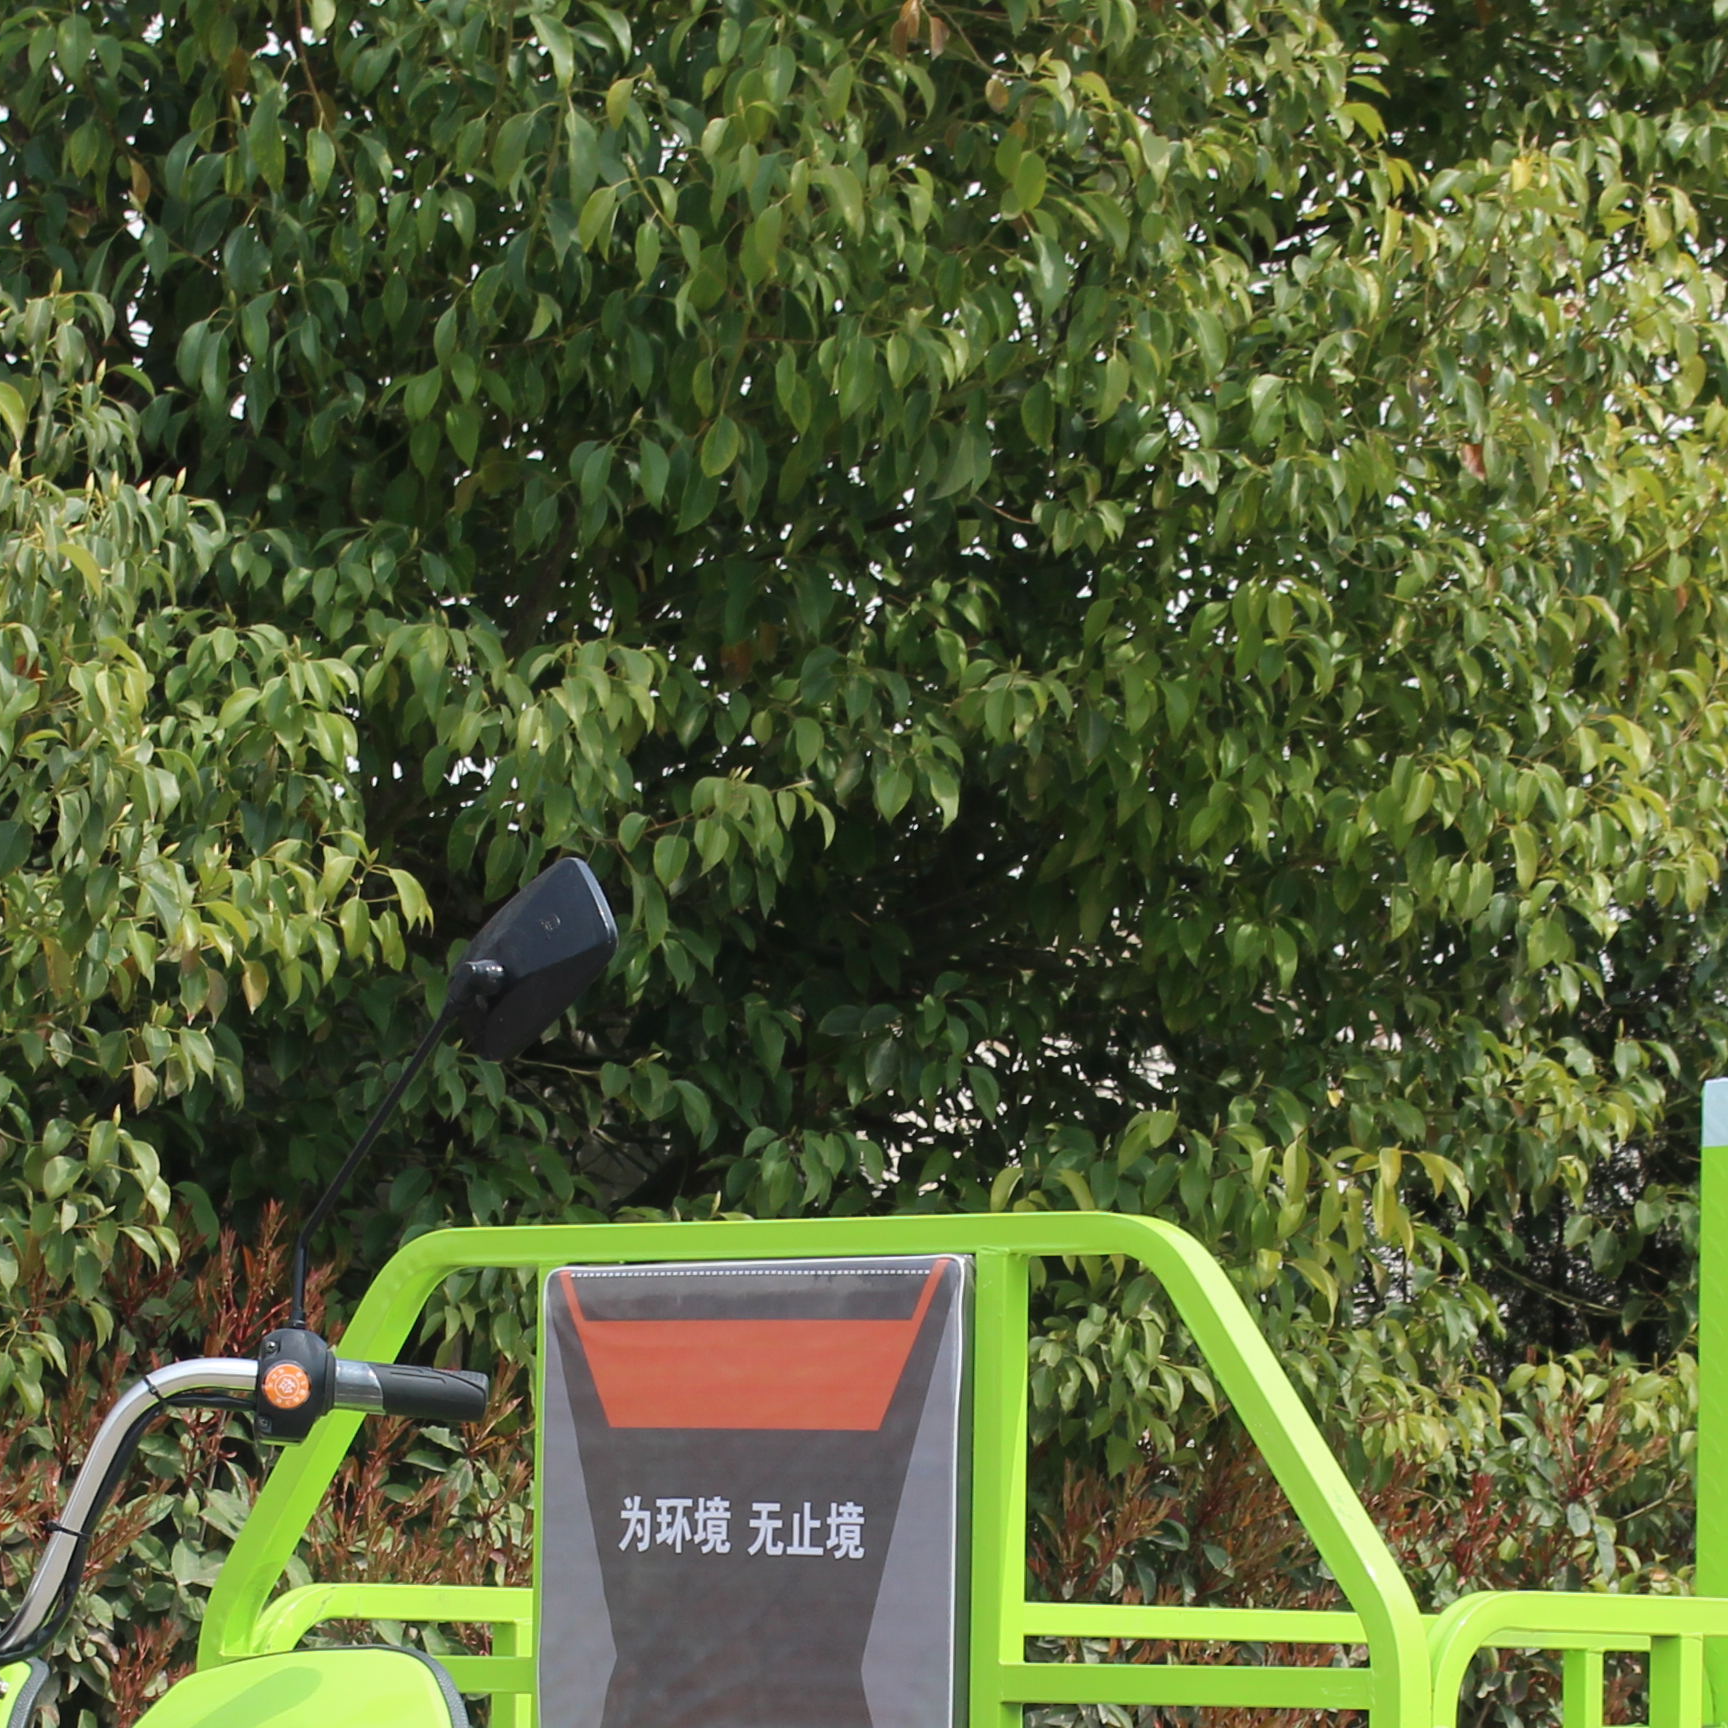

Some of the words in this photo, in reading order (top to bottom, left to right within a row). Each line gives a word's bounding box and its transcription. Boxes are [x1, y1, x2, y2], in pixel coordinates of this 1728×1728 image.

[618, 1495, 731, 1554] 为环境
[747, 1501, 865, 1559] 无止境
